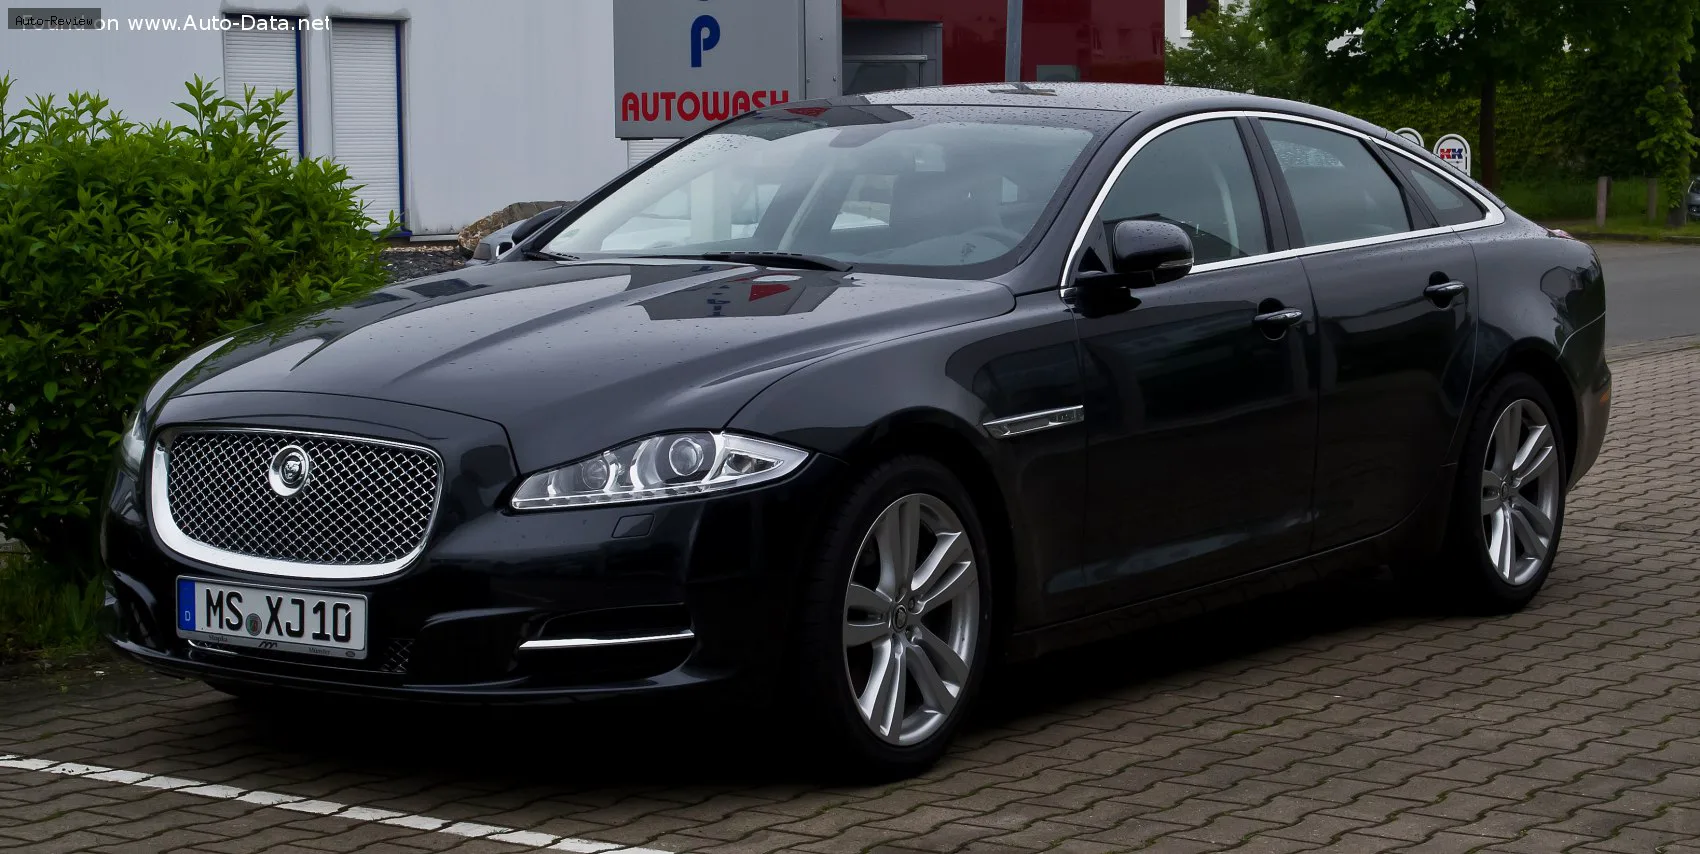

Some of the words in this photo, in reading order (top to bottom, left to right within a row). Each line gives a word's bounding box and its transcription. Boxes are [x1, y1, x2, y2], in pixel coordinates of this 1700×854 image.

[690, 14, 721, 68] P
[184, 610, 191, 622] D
[206, 590, 243, 631] MS
